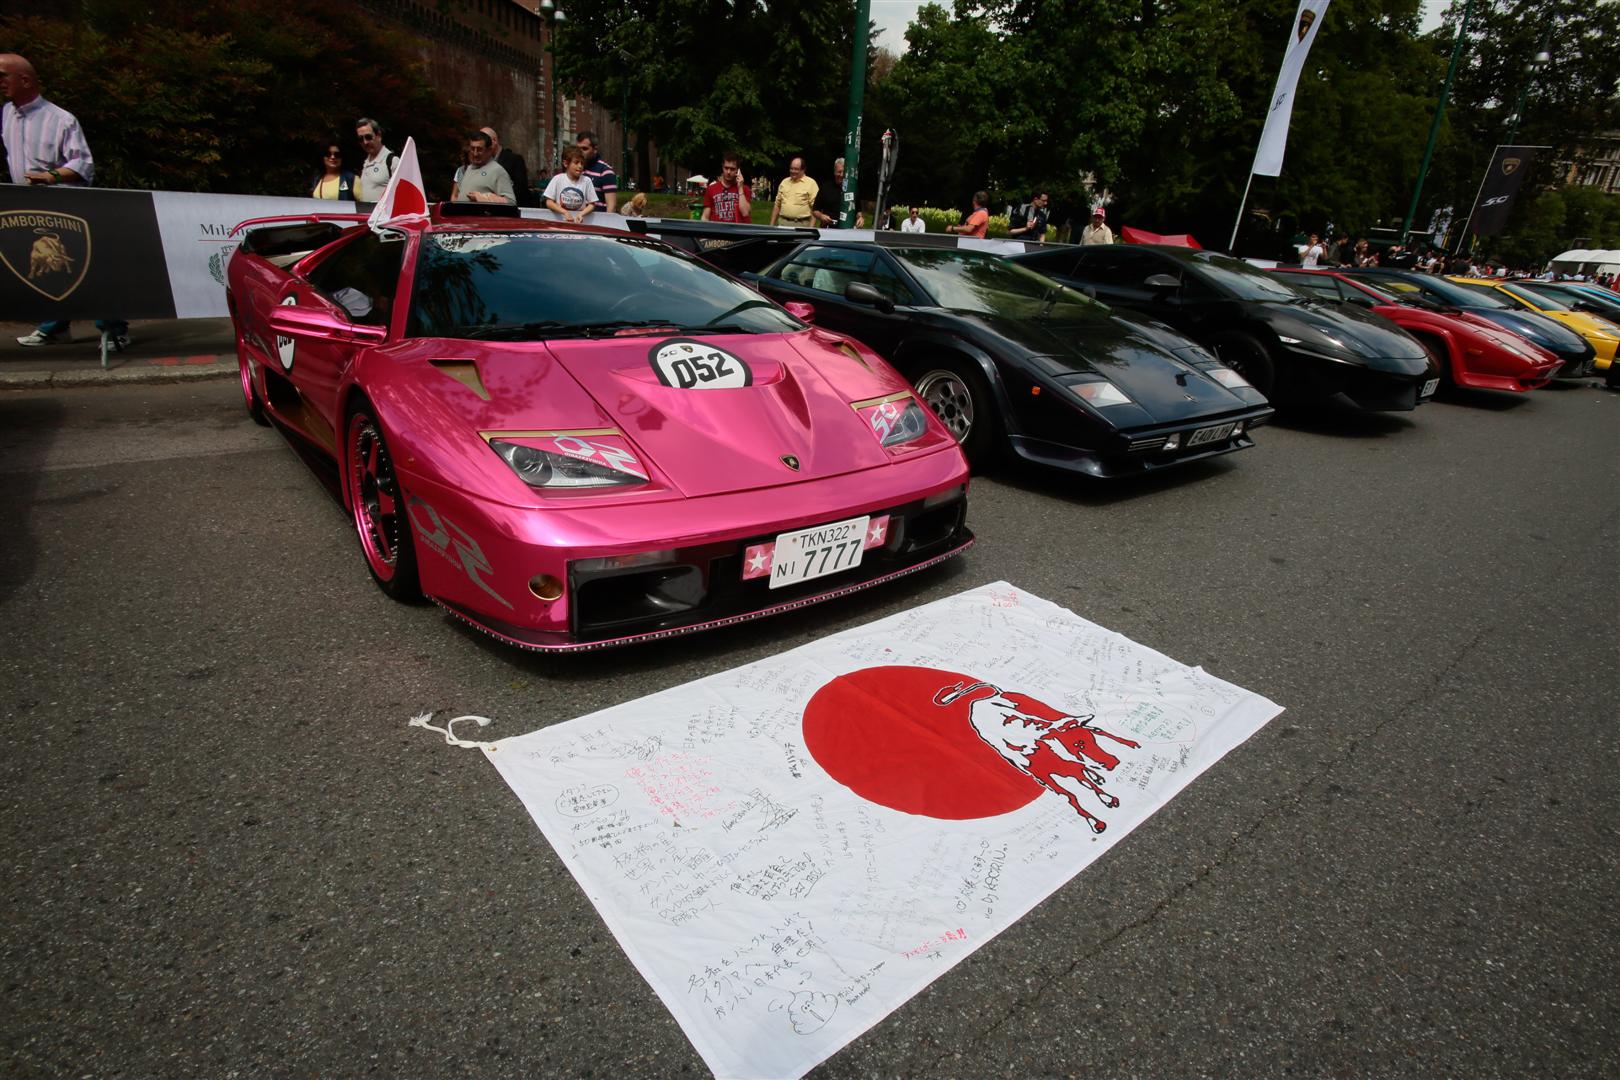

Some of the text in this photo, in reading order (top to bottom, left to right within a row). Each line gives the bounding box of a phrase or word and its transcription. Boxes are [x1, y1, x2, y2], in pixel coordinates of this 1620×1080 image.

[0, 216, 82, 233] AMBORGHINI
[671, 352, 735, 389] 052
[799, 525, 850, 549] TKN322
[803, 539, 862, 578] 7777
